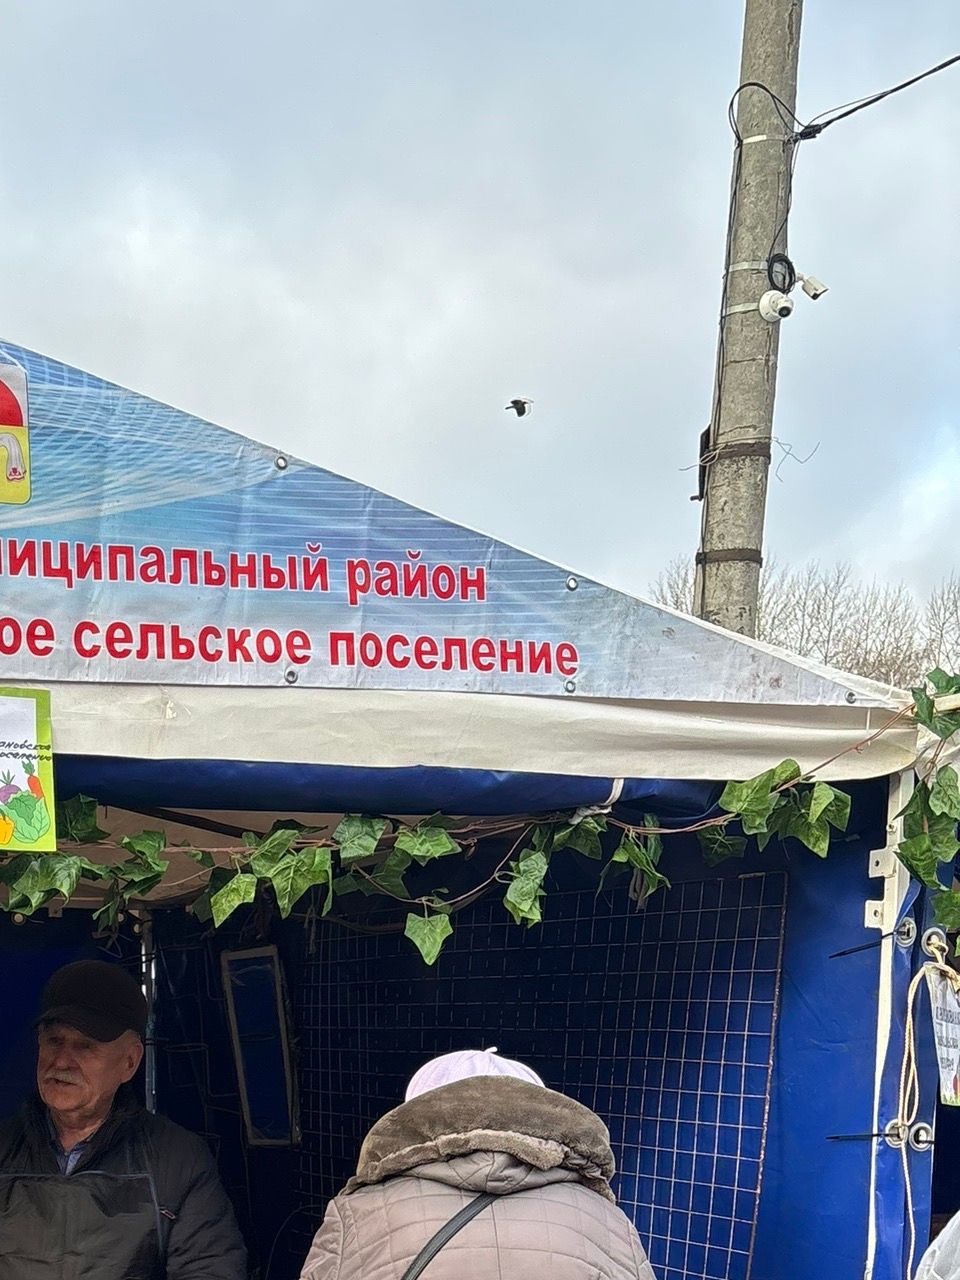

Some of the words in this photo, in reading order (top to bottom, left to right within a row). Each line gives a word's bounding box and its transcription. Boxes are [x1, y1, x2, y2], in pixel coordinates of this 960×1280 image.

[345, 549, 487, 606] район
[72, 620, 313, 666] сельское
[328, 629, 580, 677] поселение
